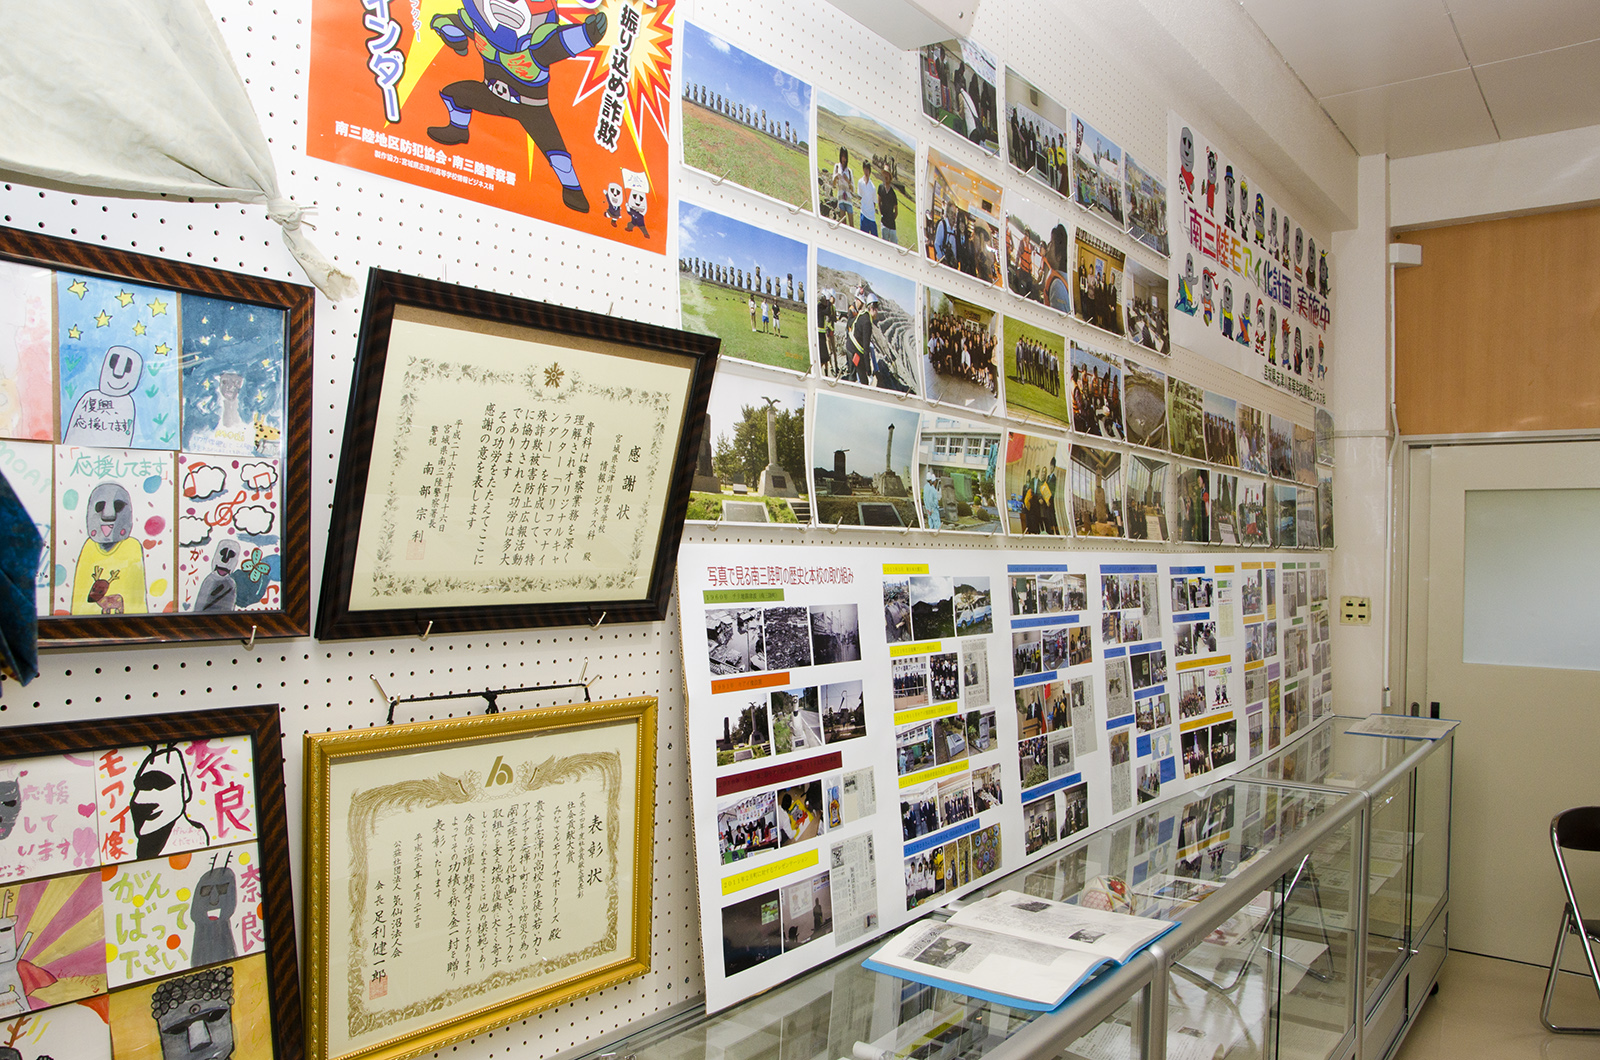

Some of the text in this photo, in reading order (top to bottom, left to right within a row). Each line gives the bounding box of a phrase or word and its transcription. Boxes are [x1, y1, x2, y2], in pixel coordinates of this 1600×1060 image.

[595, 3, 642, 153] 振り込め詐欺
[73, 415, 132, 435] 応援してます!
[503, 407, 523, 479] であります
[411, 461, 434, 543] 南部宗利
[428, 424, 452, 529] 宮城県南三陸警察署長
[438, 419, 463, 533] 平成二十六年十月十六日
[466, 402, 497, 530] 感謝の意を表します
[587, 460, 609, 541] 情報ビジネス科
[598, 433, 623, 534] 宮城県志津川高等学校
[616, 445, 642, 521] 感謝状
[706, 566, 855, 587] 写真で見る南三陸町の歴史と本校の取り組み
[22, 780, 69, 804] 応援
[24, 814, 58, 834] して
[99, 749, 131, 861] モアイ像
[108, 870, 170, 903] がん
[431, 818, 446, 900] 表彰いたします
[586, 814, 604, 886] 表彰状
[115, 902, 190, 945] ばって
[240, 864, 264, 952] 奈良
[548, 927, 562, 941] 殿
[119, 944, 189, 979] 下さい
